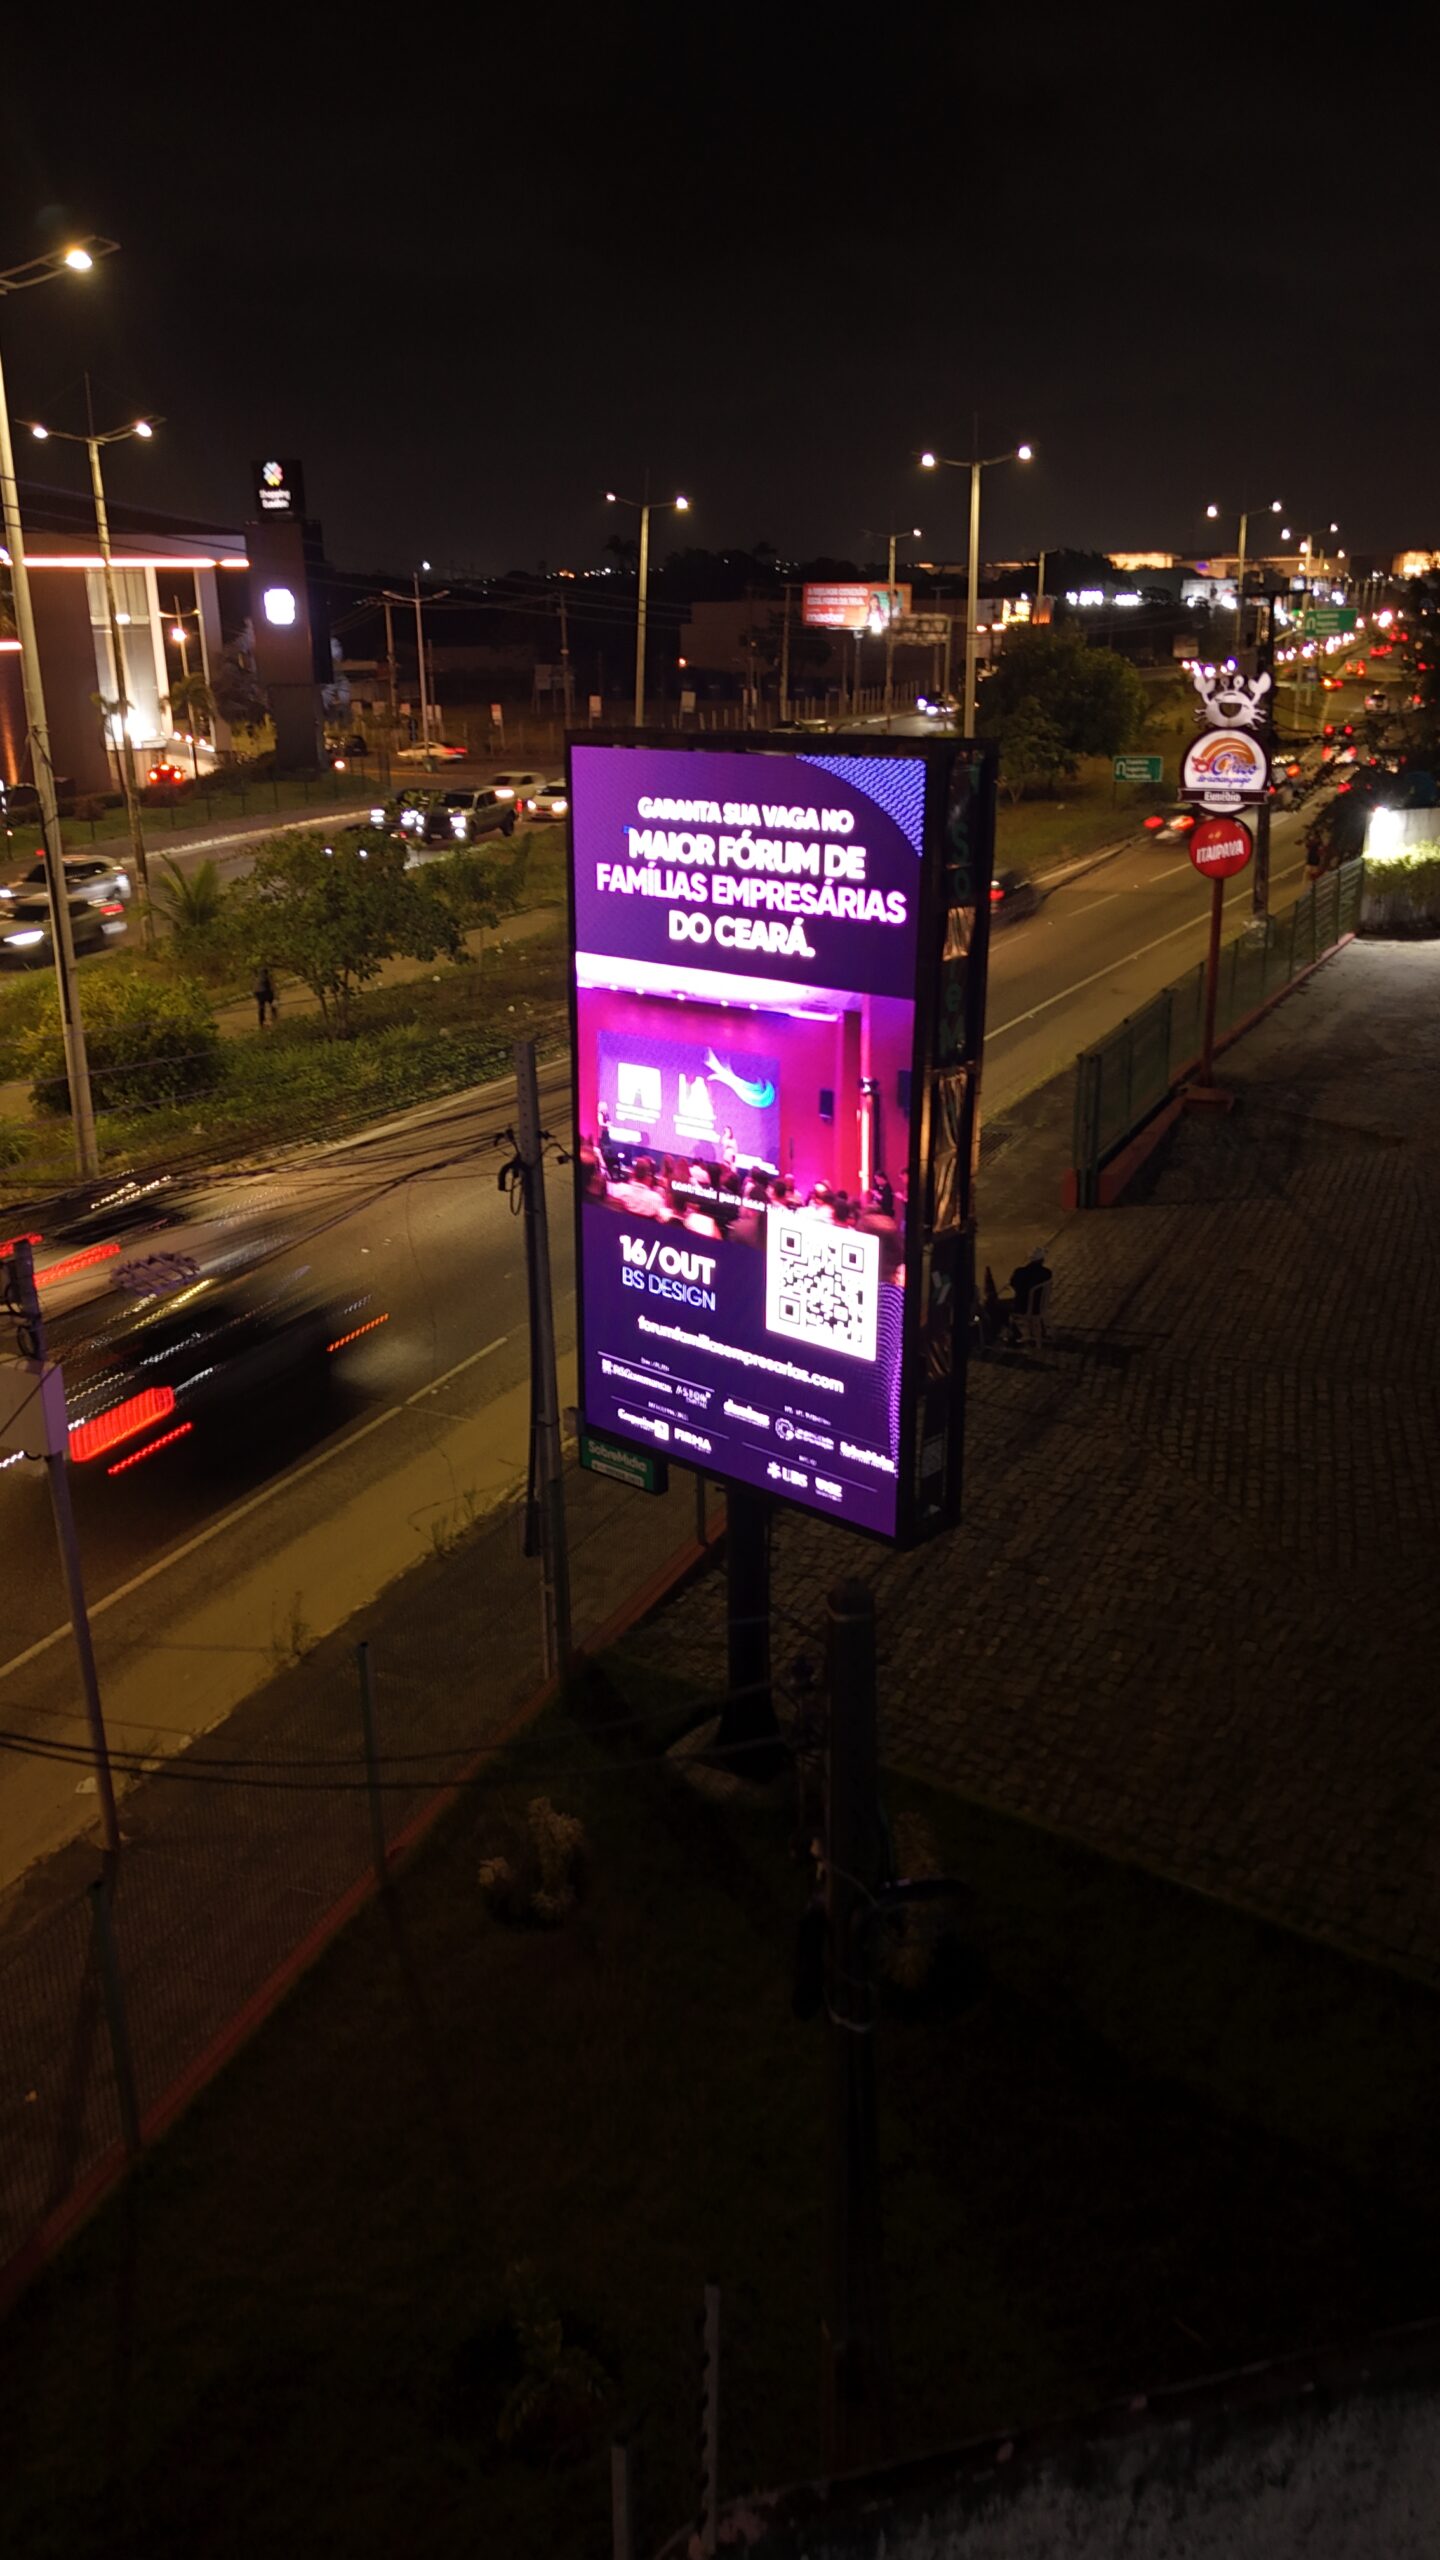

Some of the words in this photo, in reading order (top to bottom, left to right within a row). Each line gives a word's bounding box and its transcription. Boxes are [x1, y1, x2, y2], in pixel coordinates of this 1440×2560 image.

[637, 796, 721, 824] GARANTA
[722, 803, 760, 827] SUA
[761, 804, 819, 831] VAGA
[821, 808, 855, 834] NO
[628, 828, 715, 866] MAIOR
[719, 830, 819, 875] FÓRUM
[824, 844, 867, 880] DE
[1196, 839, 1245, 864] ITAIPAVA
[596, 862, 708, 902] FAMÍLIAS
[712, 874, 908, 924] EMPRESÁRIAS
[668, 910, 711, 944] DO
[714, 915, 816, 958] CEARÁ.
[618, 1234, 716, 1286] 16/OUT
[621, 1266, 645, 1291] BS
[648, 1272, 716, 1312] DESIGN
